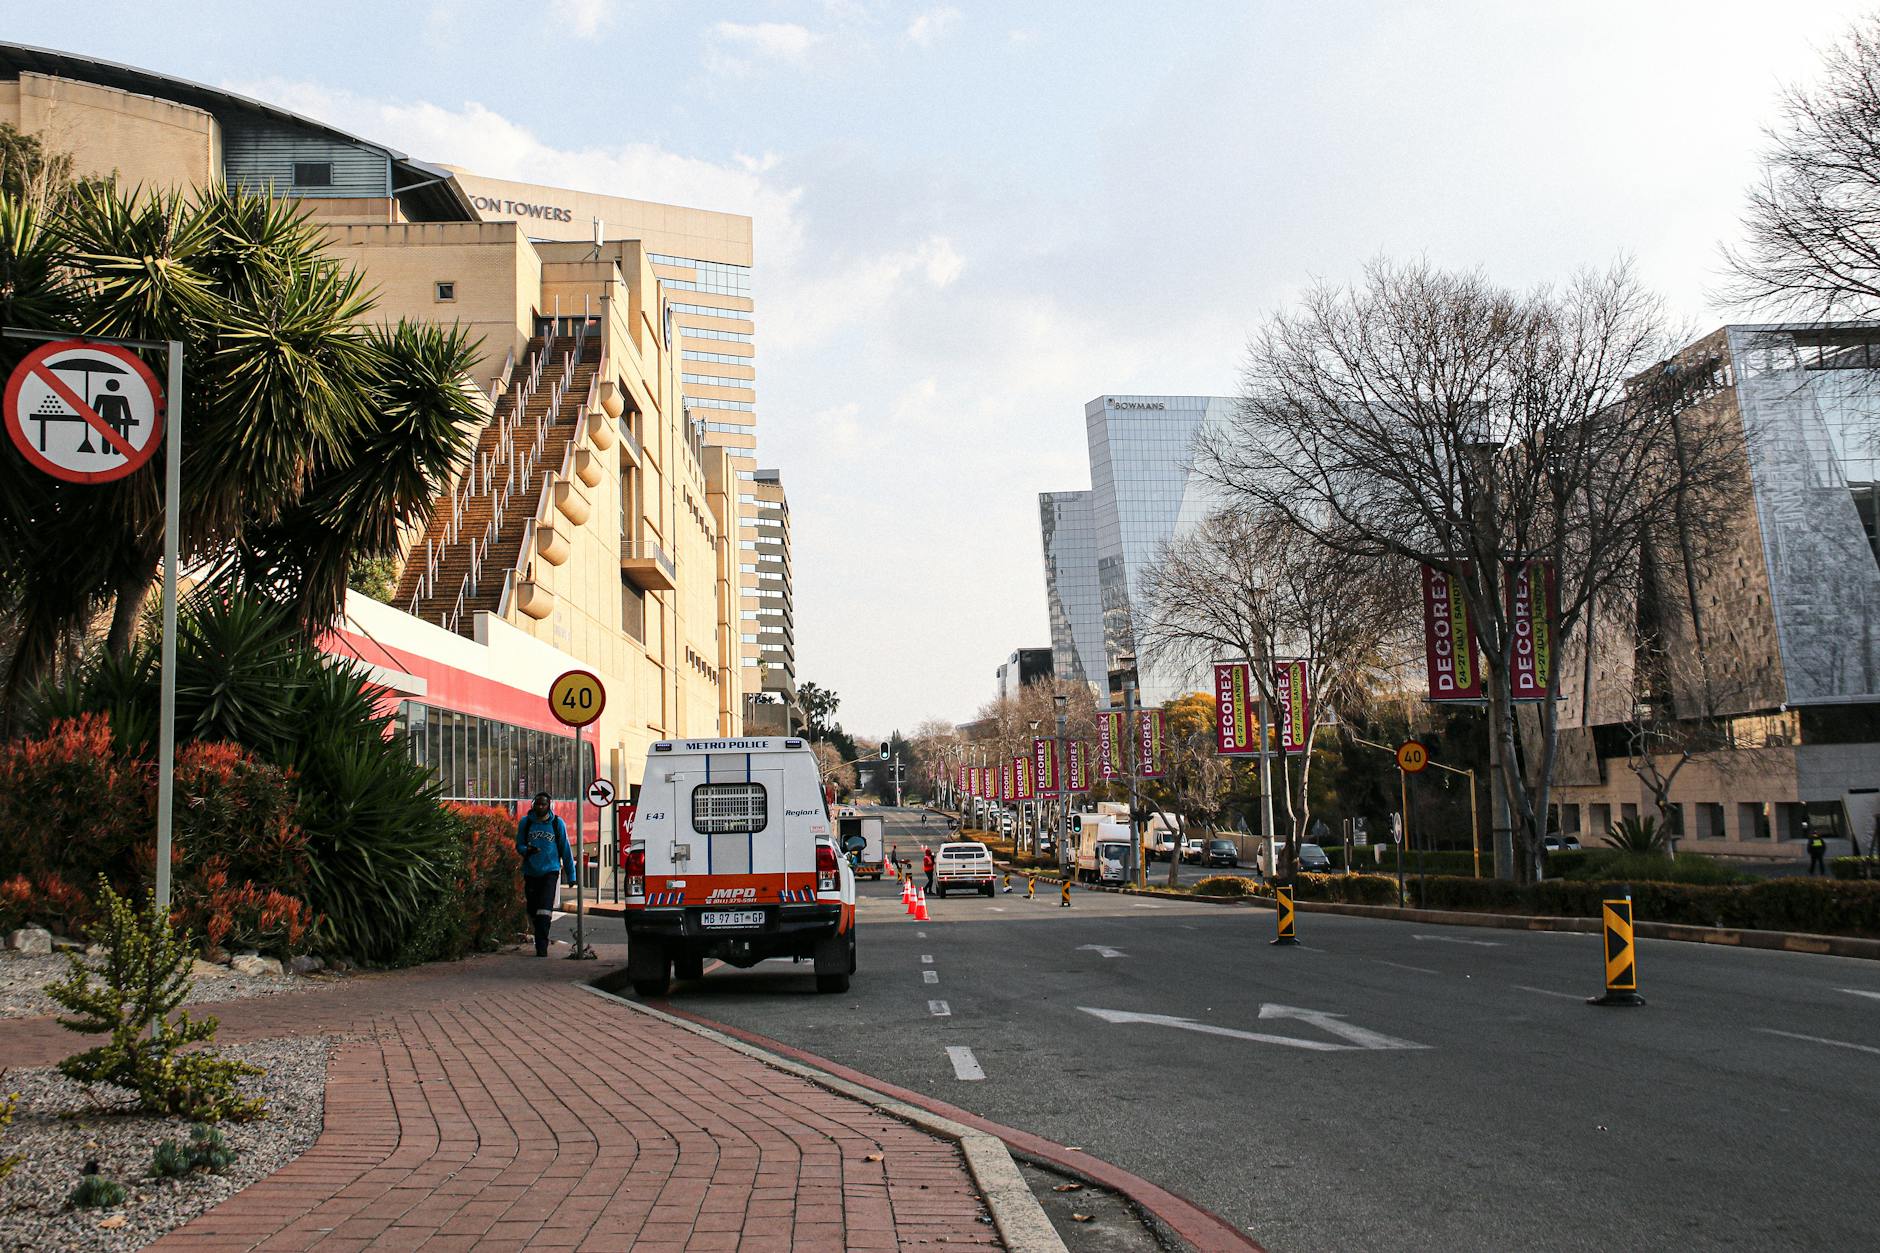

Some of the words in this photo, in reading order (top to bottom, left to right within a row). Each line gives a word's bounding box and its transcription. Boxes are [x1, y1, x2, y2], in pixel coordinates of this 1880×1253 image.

[504, 201, 572, 222] TOWERS
[1115, 402, 1165, 410] BOWMANS
[1431, 567, 1454, 691] DECOREX
[1455, 627, 1465, 653] JULY
[1536, 627, 1545, 652] JULY
[1457, 654, 1467, 685] 24-27
[1537, 652, 1547, 684] 24-27
[562, 687, 592, 709] 40
[1220, 668, 1235, 749] DECOREX
[686, 741, 726, 750] METRO
[729, 740, 769, 749] POLICE
[1143, 714, 1153, 773] DECOREX
[1404, 750, 1421, 763] 40
[1016, 758, 1024, 798] DECOREX
[1037, 741, 1045, 789] DECOREX
[1070, 741, 1078, 789] DECOREX
[785, 809, 813, 817] Region
[706, 887, 757, 899] JMPD
